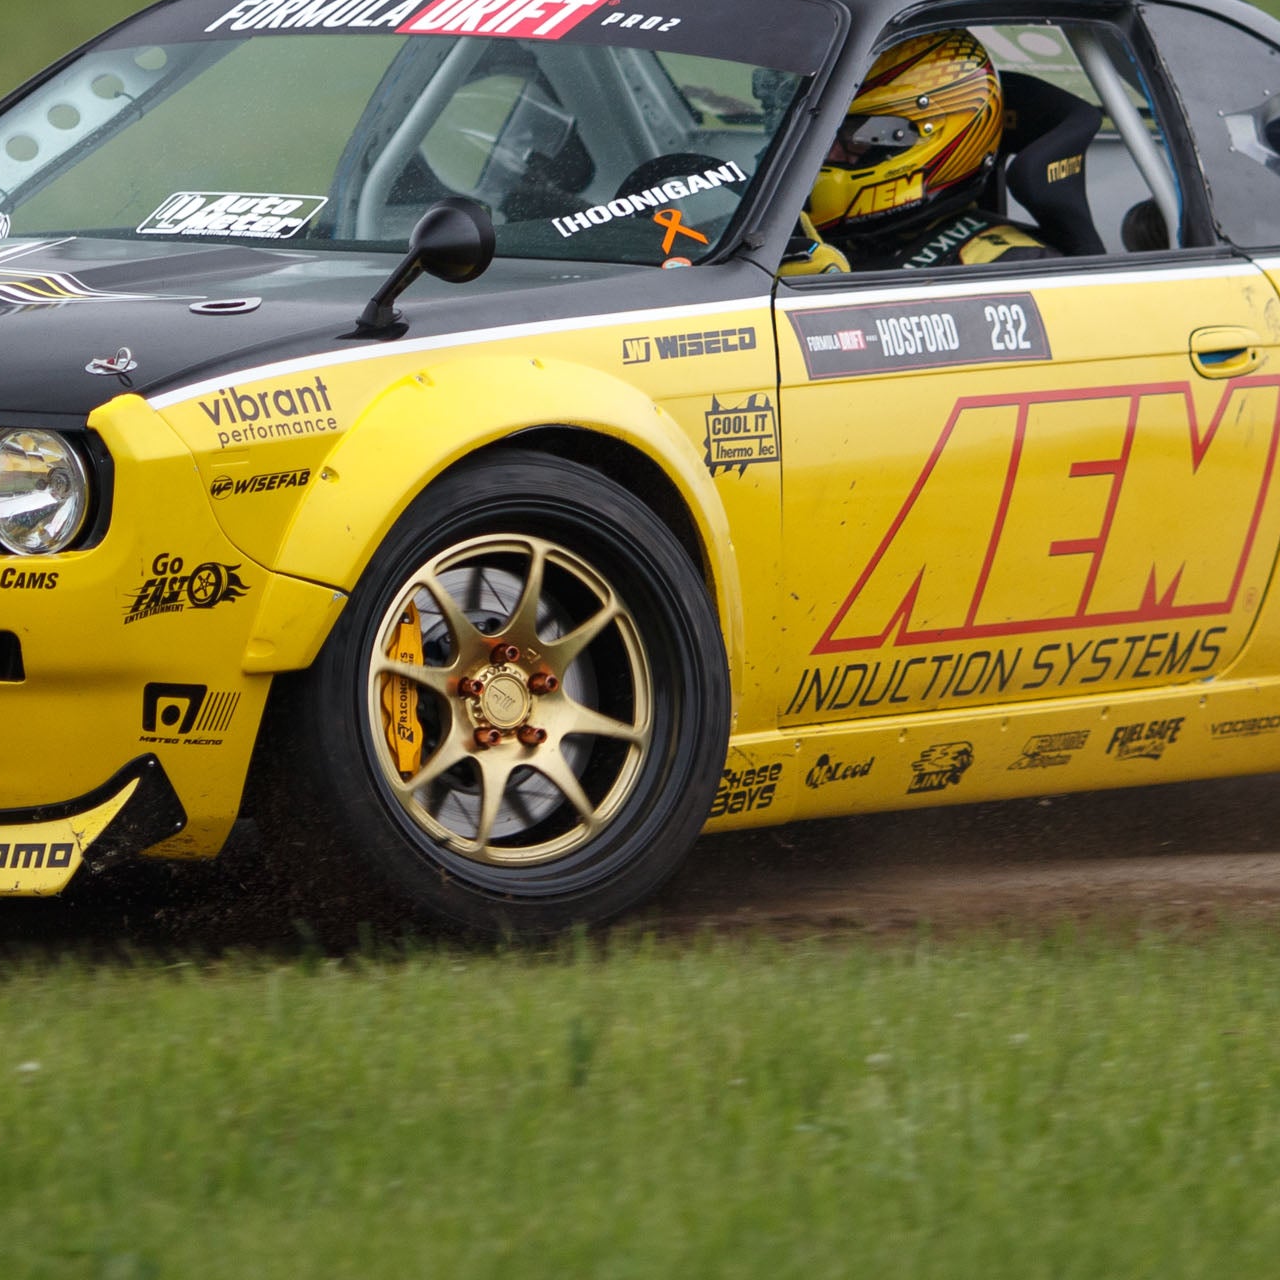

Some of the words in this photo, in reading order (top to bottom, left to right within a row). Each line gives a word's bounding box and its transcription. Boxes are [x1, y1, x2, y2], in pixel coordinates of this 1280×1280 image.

[601, 11, 682, 33] PRO2
[205, 195, 304, 216] Auto
[551, 160, 748, 238] [HOONIGAN]
[844, 169, 924, 218] AEM
[903, 216, 988, 270] TAKA
[876, 313, 961, 357] HOSFORD
[984, 304, 1032, 351] 232
[198, 375, 332, 426] vibrant
[217, 416, 337, 449] performance
[712, 415, 751, 436] COOL
[754, 413, 768, 433] IT
[713, 438, 754, 459] Thermo
[758, 437, 775, 456] Tec
[234, 468, 311, 495] WISEFAB
[151, 552, 184, 576] Go
[129, 575, 191, 614] FAST
[123, 603, 185, 625] ENTERTAINMENT
[785, 647, 1022, 716] INDUCTION
[1020, 626, 1227, 691] SYSTEMS
[183, 738, 223, 746] RACING
